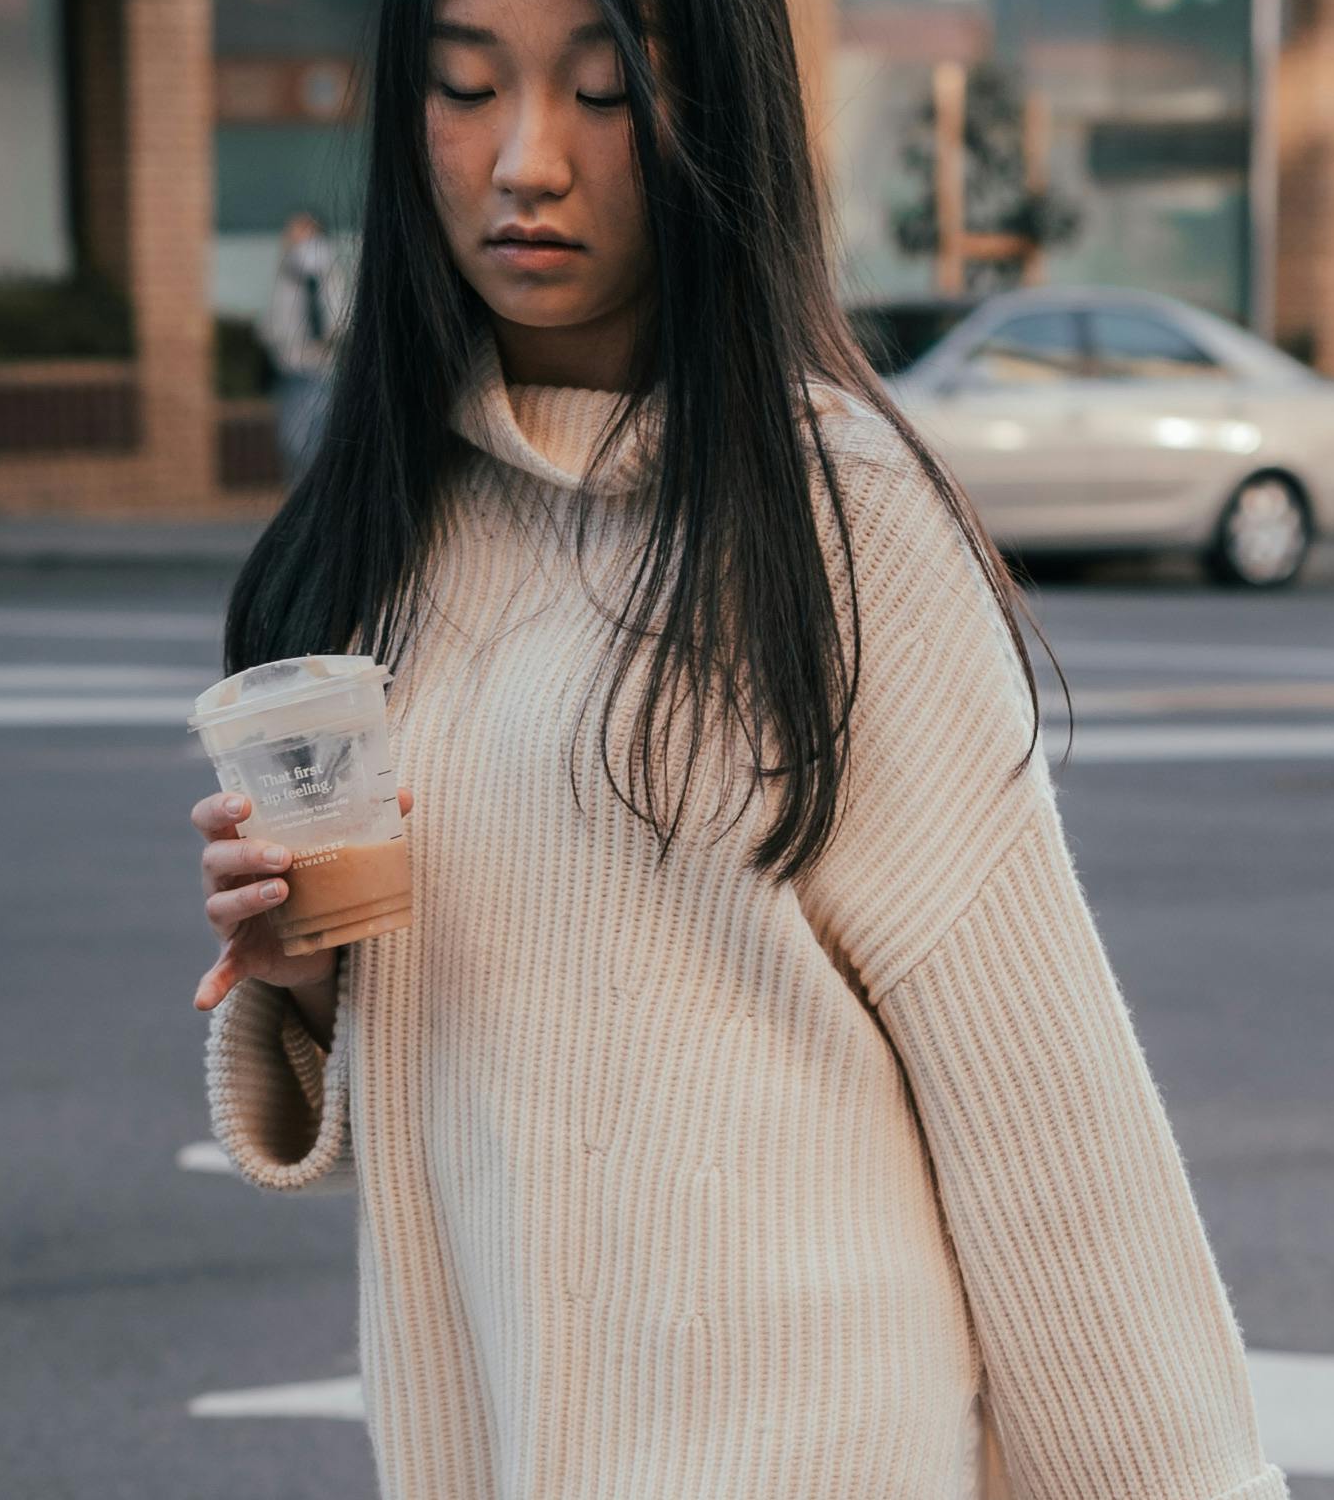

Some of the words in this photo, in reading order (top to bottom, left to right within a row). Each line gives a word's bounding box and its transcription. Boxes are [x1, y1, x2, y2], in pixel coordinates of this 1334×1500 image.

[259, 770, 292, 787] That
[294, 763, 324, 780] first
[262, 791, 281, 806] sip
[283, 780, 332, 799] feeling.
[293, 839, 346, 860] ARBUCKS
[293, 853, 338, 870] REWARDS
